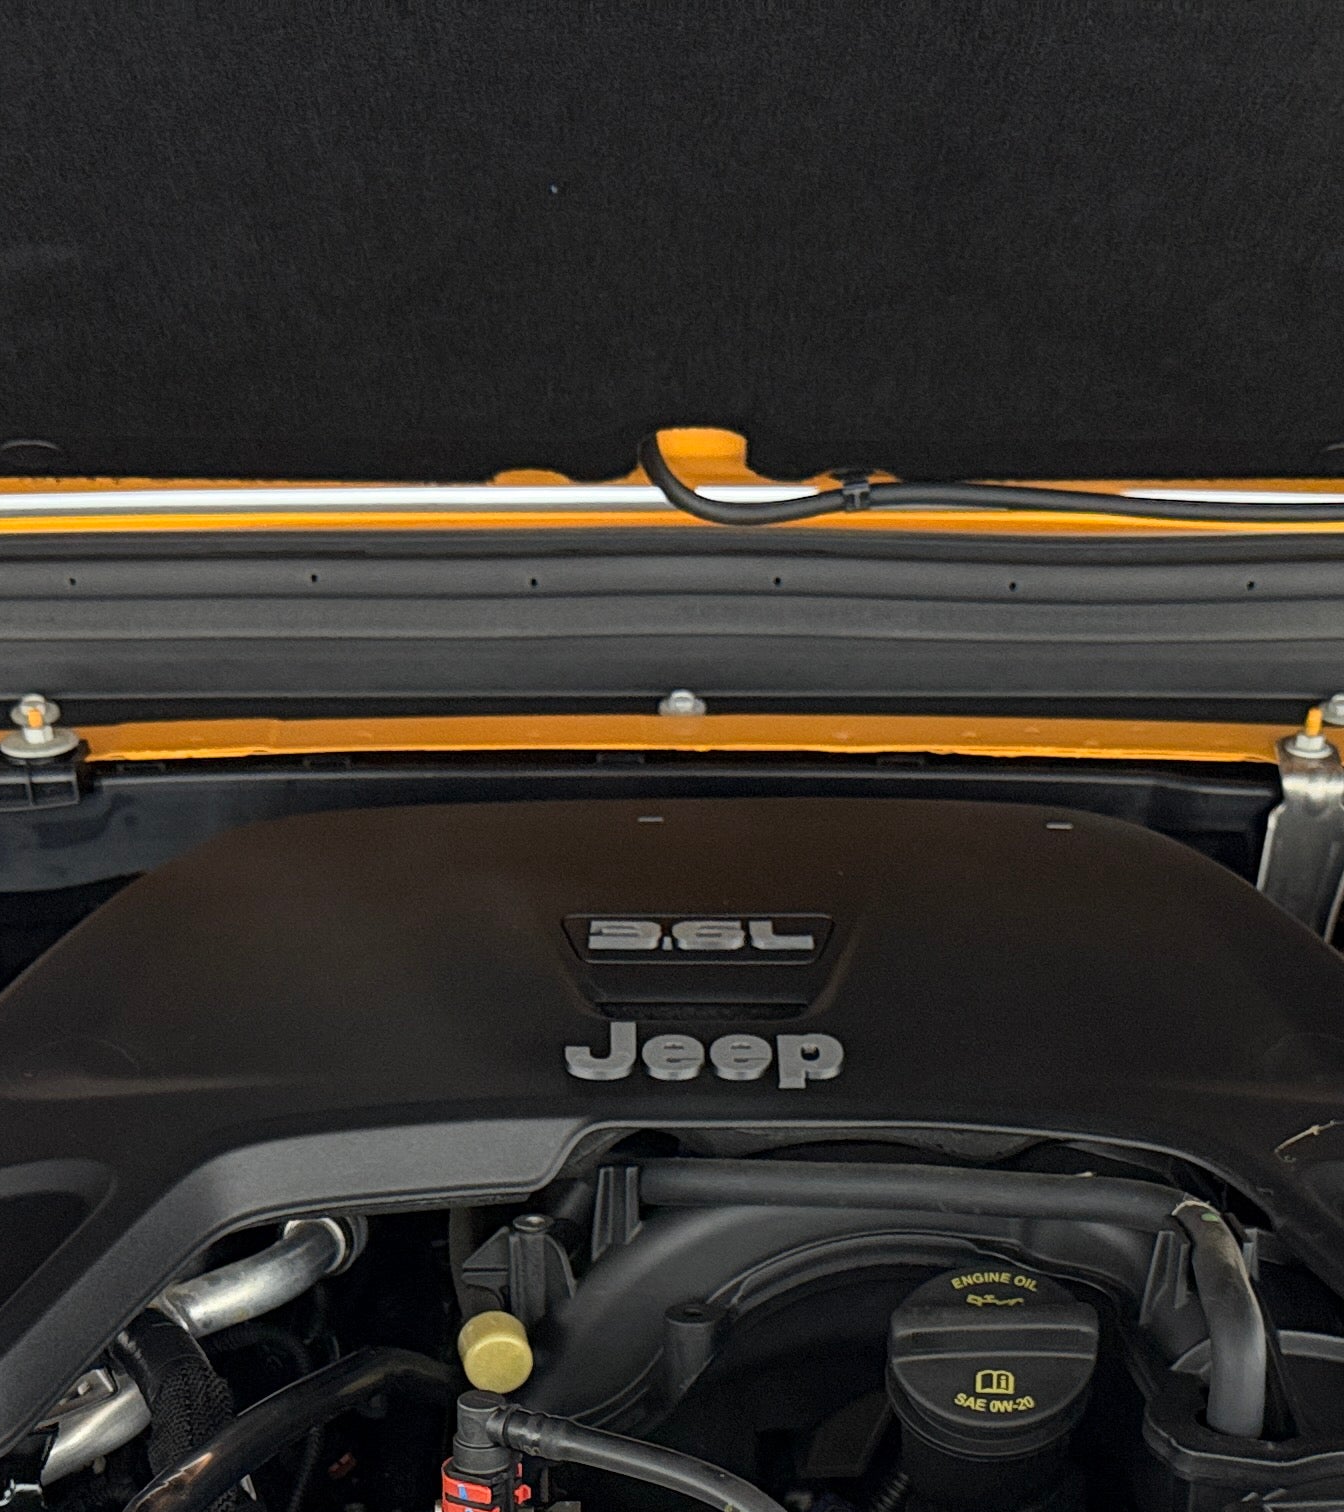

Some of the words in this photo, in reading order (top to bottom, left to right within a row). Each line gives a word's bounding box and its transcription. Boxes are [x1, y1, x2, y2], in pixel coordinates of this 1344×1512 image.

[587, 919, 816, 951] 3.6L
[564, 1021, 844, 1089] Jeep
[951, 1271, 1011, 1290] ENGINE
[1014, 1275, 1039, 1292] OIL
[954, 1392, 986, 1412] SAE
[989, 1395, 1035, 1413] 0W-20
